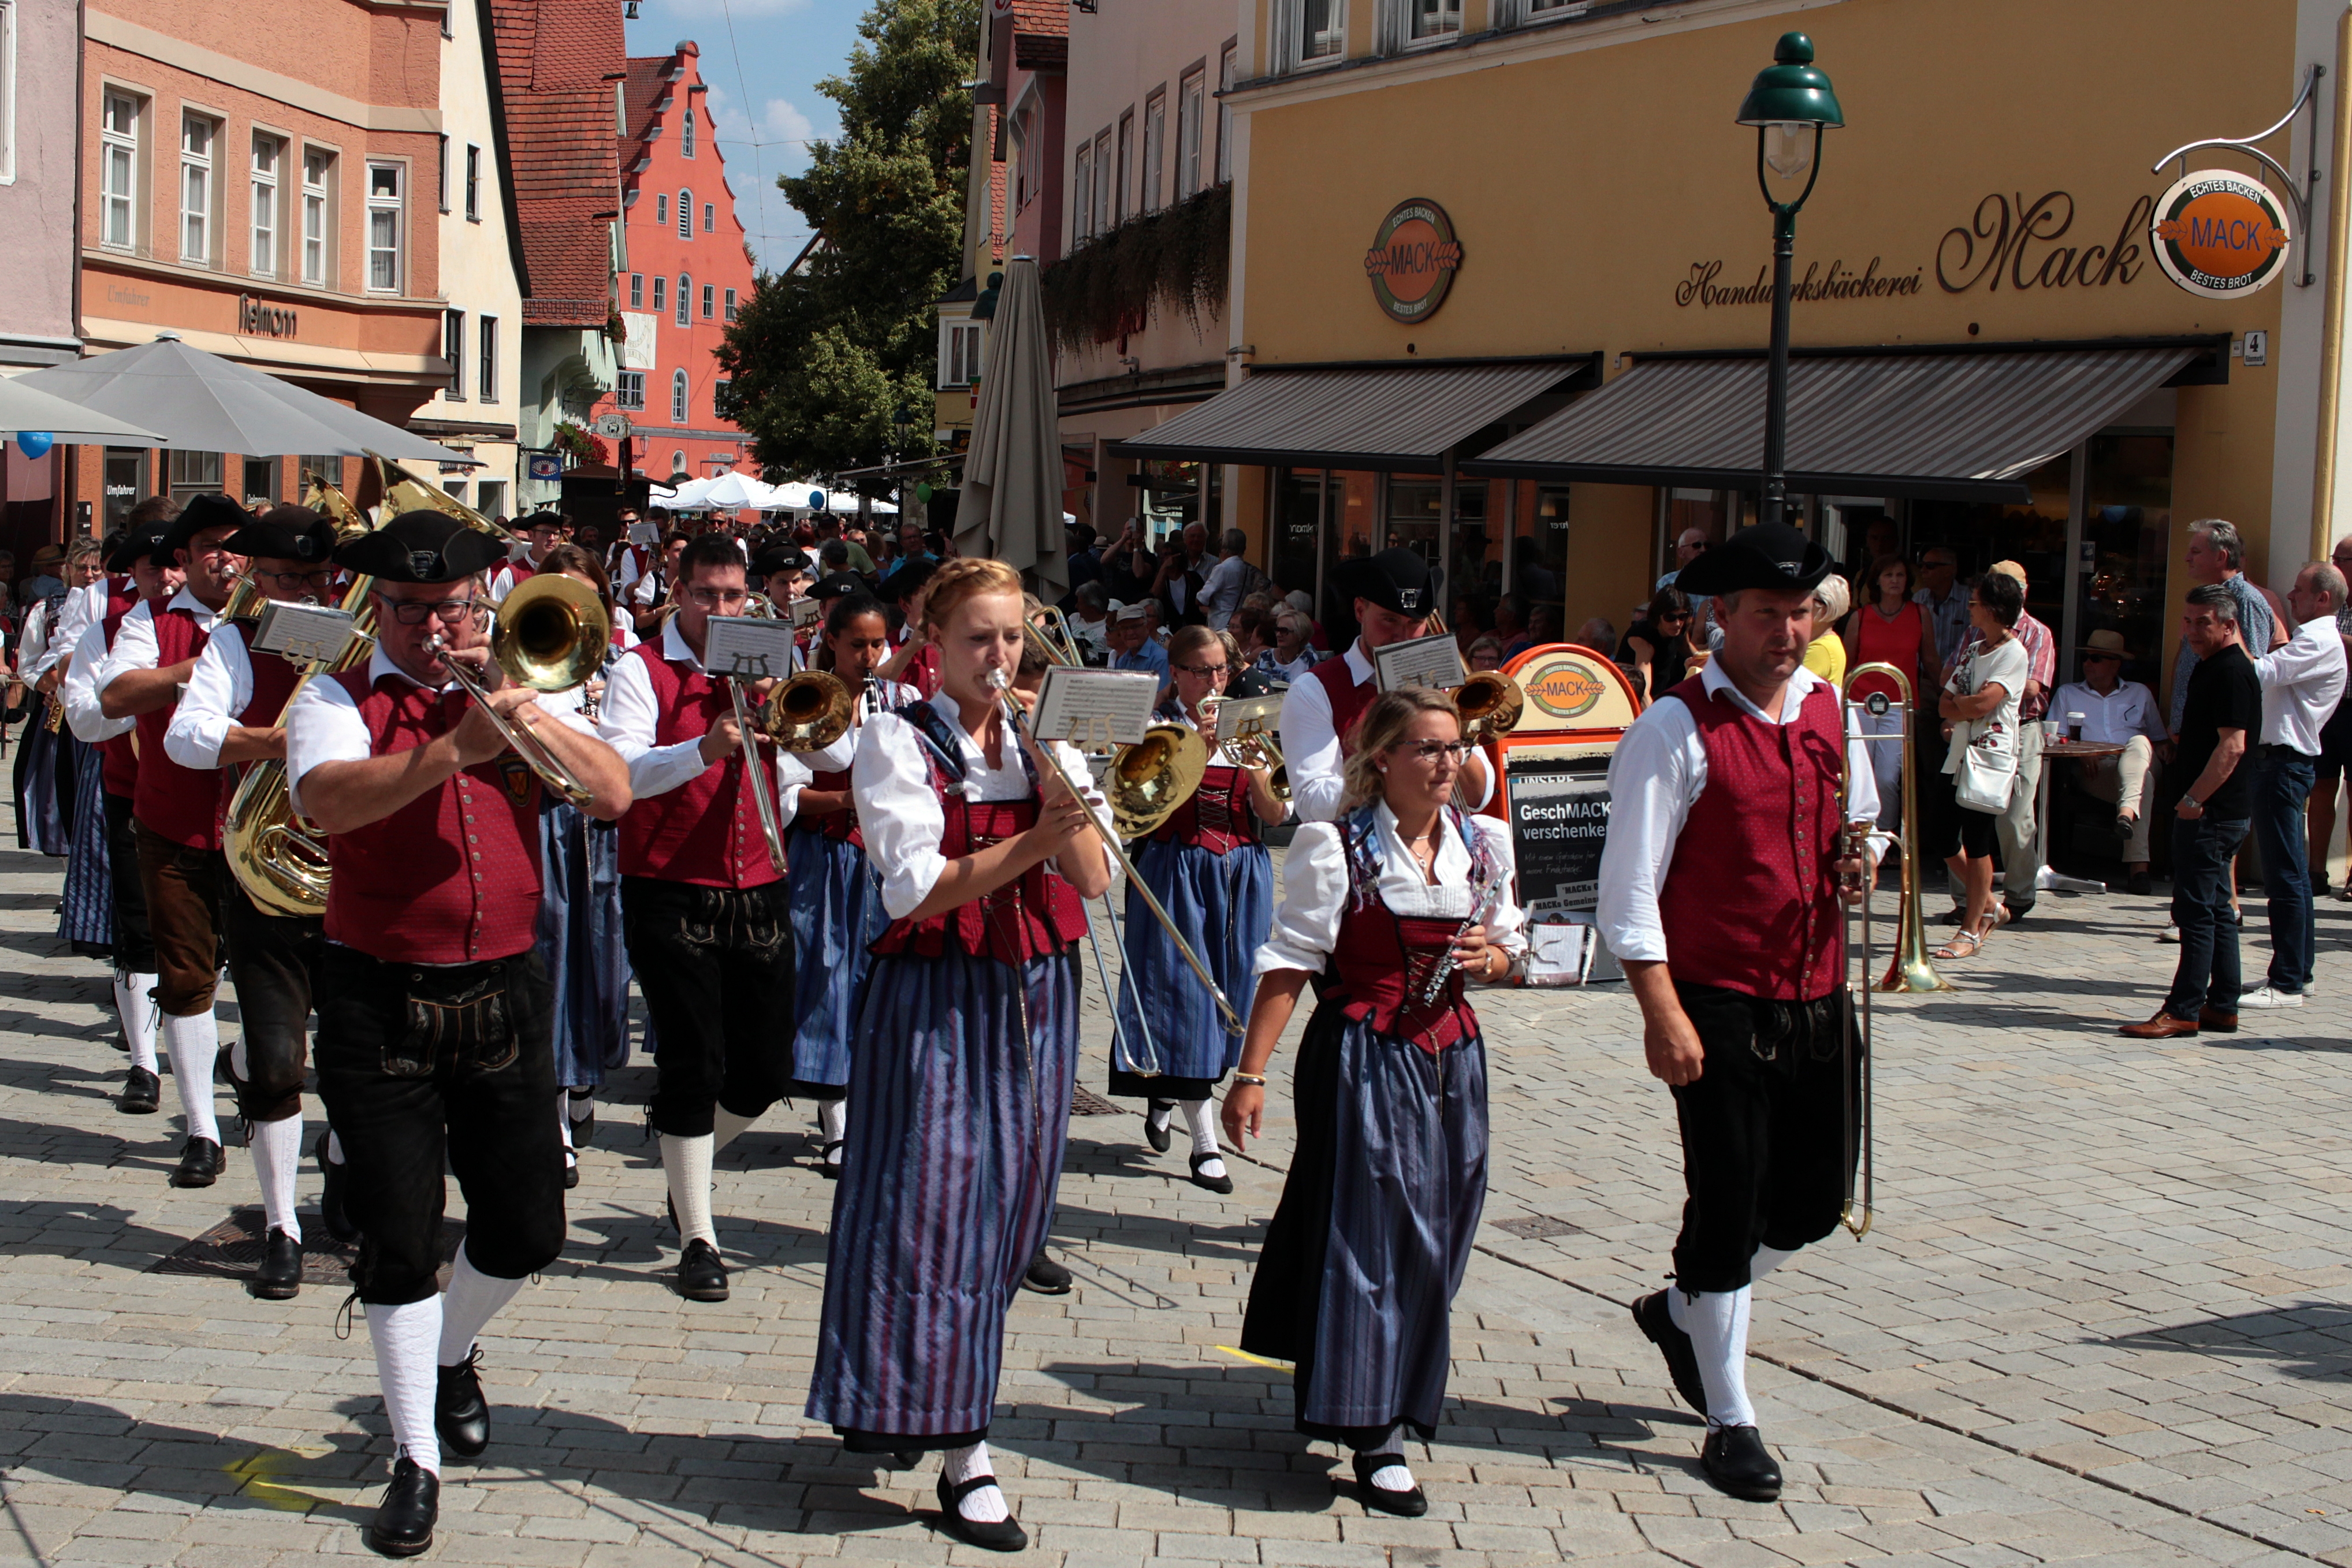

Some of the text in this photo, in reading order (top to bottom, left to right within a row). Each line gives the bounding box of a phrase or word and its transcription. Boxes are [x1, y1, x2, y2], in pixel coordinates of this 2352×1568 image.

[2189, 180, 2261, 203] ECHTES BACKEN
[1393, 207, 1435, 228] ECHTES BACKEN
[1930, 191, 2150, 293] Mack
[2191, 217, 2261, 251] MACK
[1391, 241, 1436, 275] MACK
[1676, 256, 1922, 310] Handwrksbäckerei
[2190, 269, 2252, 289] BESTES BROT
[108, 284, 150, 308] Umfahrer
[1394, 299, 1427, 314] BESTES BROT
[2250, 334, 2258, 352] 4
[107, 485, 136, 498] Umfahrer
[1545, 665, 1581, 675] ECHTES BACKEN
[1546, 681, 1585, 697] MACK
[1520, 802, 1612, 820] GeschMACK
[1523, 822, 1608, 839] verschenke
